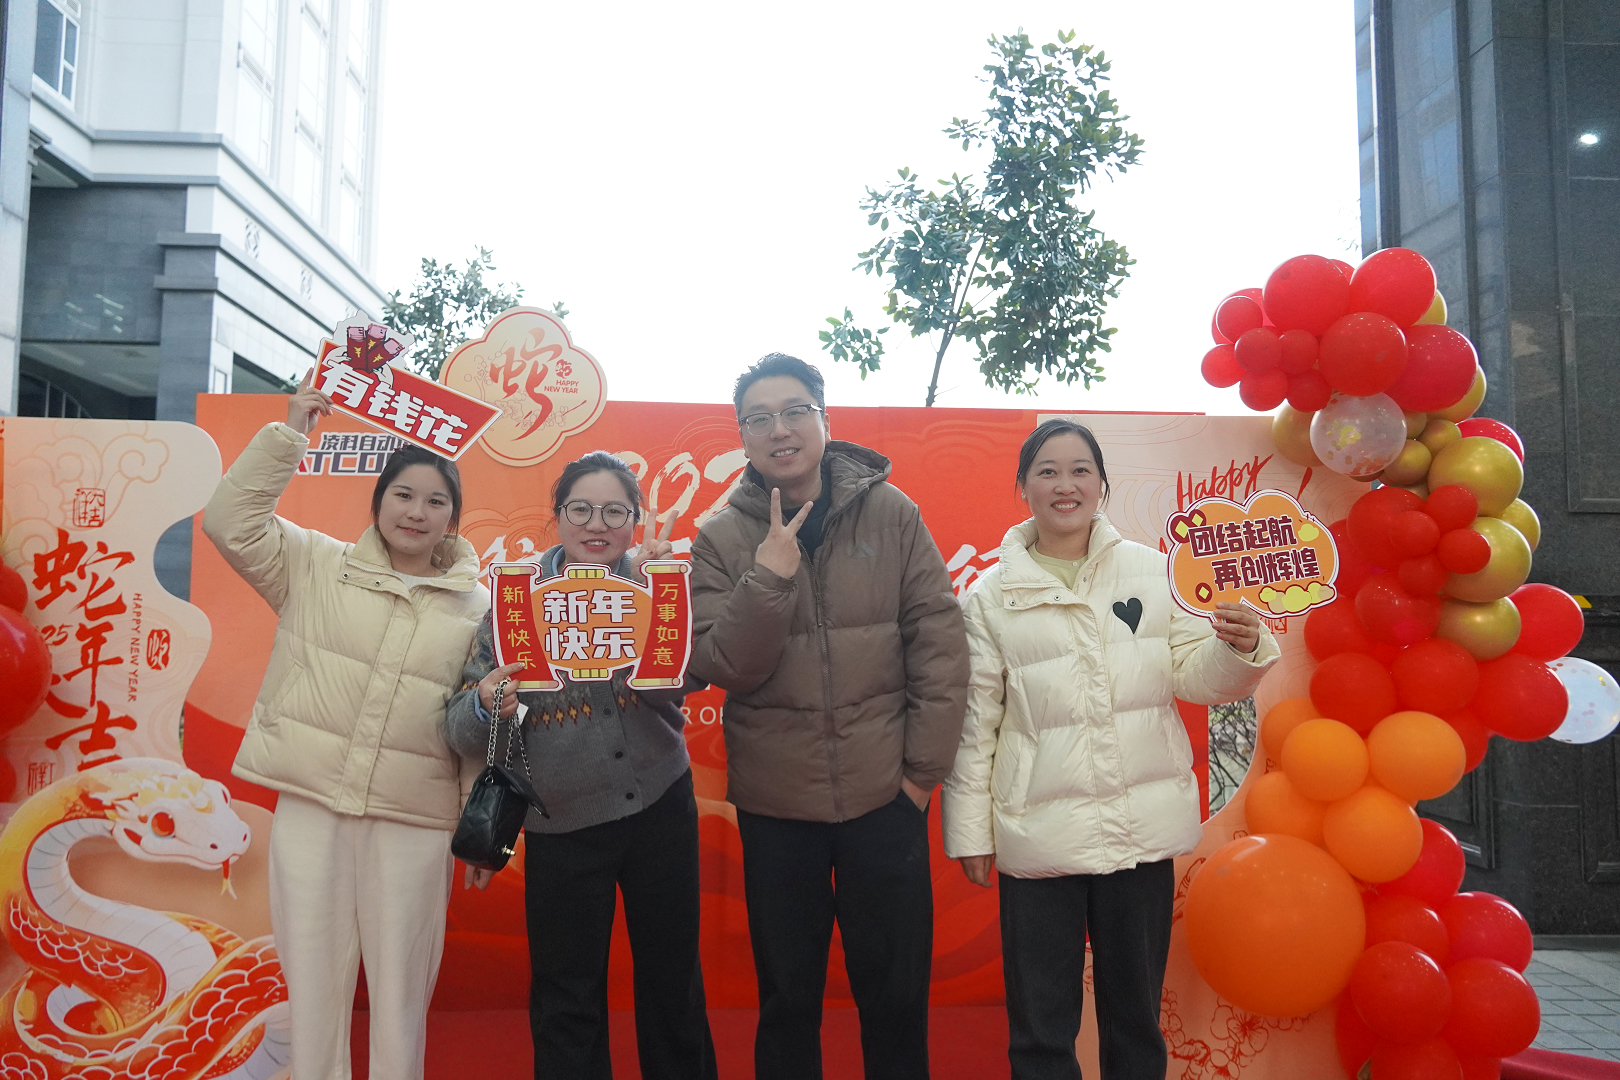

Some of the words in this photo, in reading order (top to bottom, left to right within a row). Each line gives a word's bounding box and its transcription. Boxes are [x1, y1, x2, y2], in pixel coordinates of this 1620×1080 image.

[321, 361, 468, 453] 有钱花
[1176, 453, 1274, 511] Happy
[1188, 515, 1297, 558] 团结起航
[1211, 547, 1320, 591] 再创辉煌
[131, 593, 143, 634] HAPPY
[502, 585, 536, 670] 新年快乐
[543, 589, 637, 624] 新年
[653, 584, 679, 666] 万事如意
[130, 637, 140, 666] NEW
[545, 627, 637, 660] 快乐
[128, 669, 138, 702] YEAR
[700, 706, 724, 725] O
